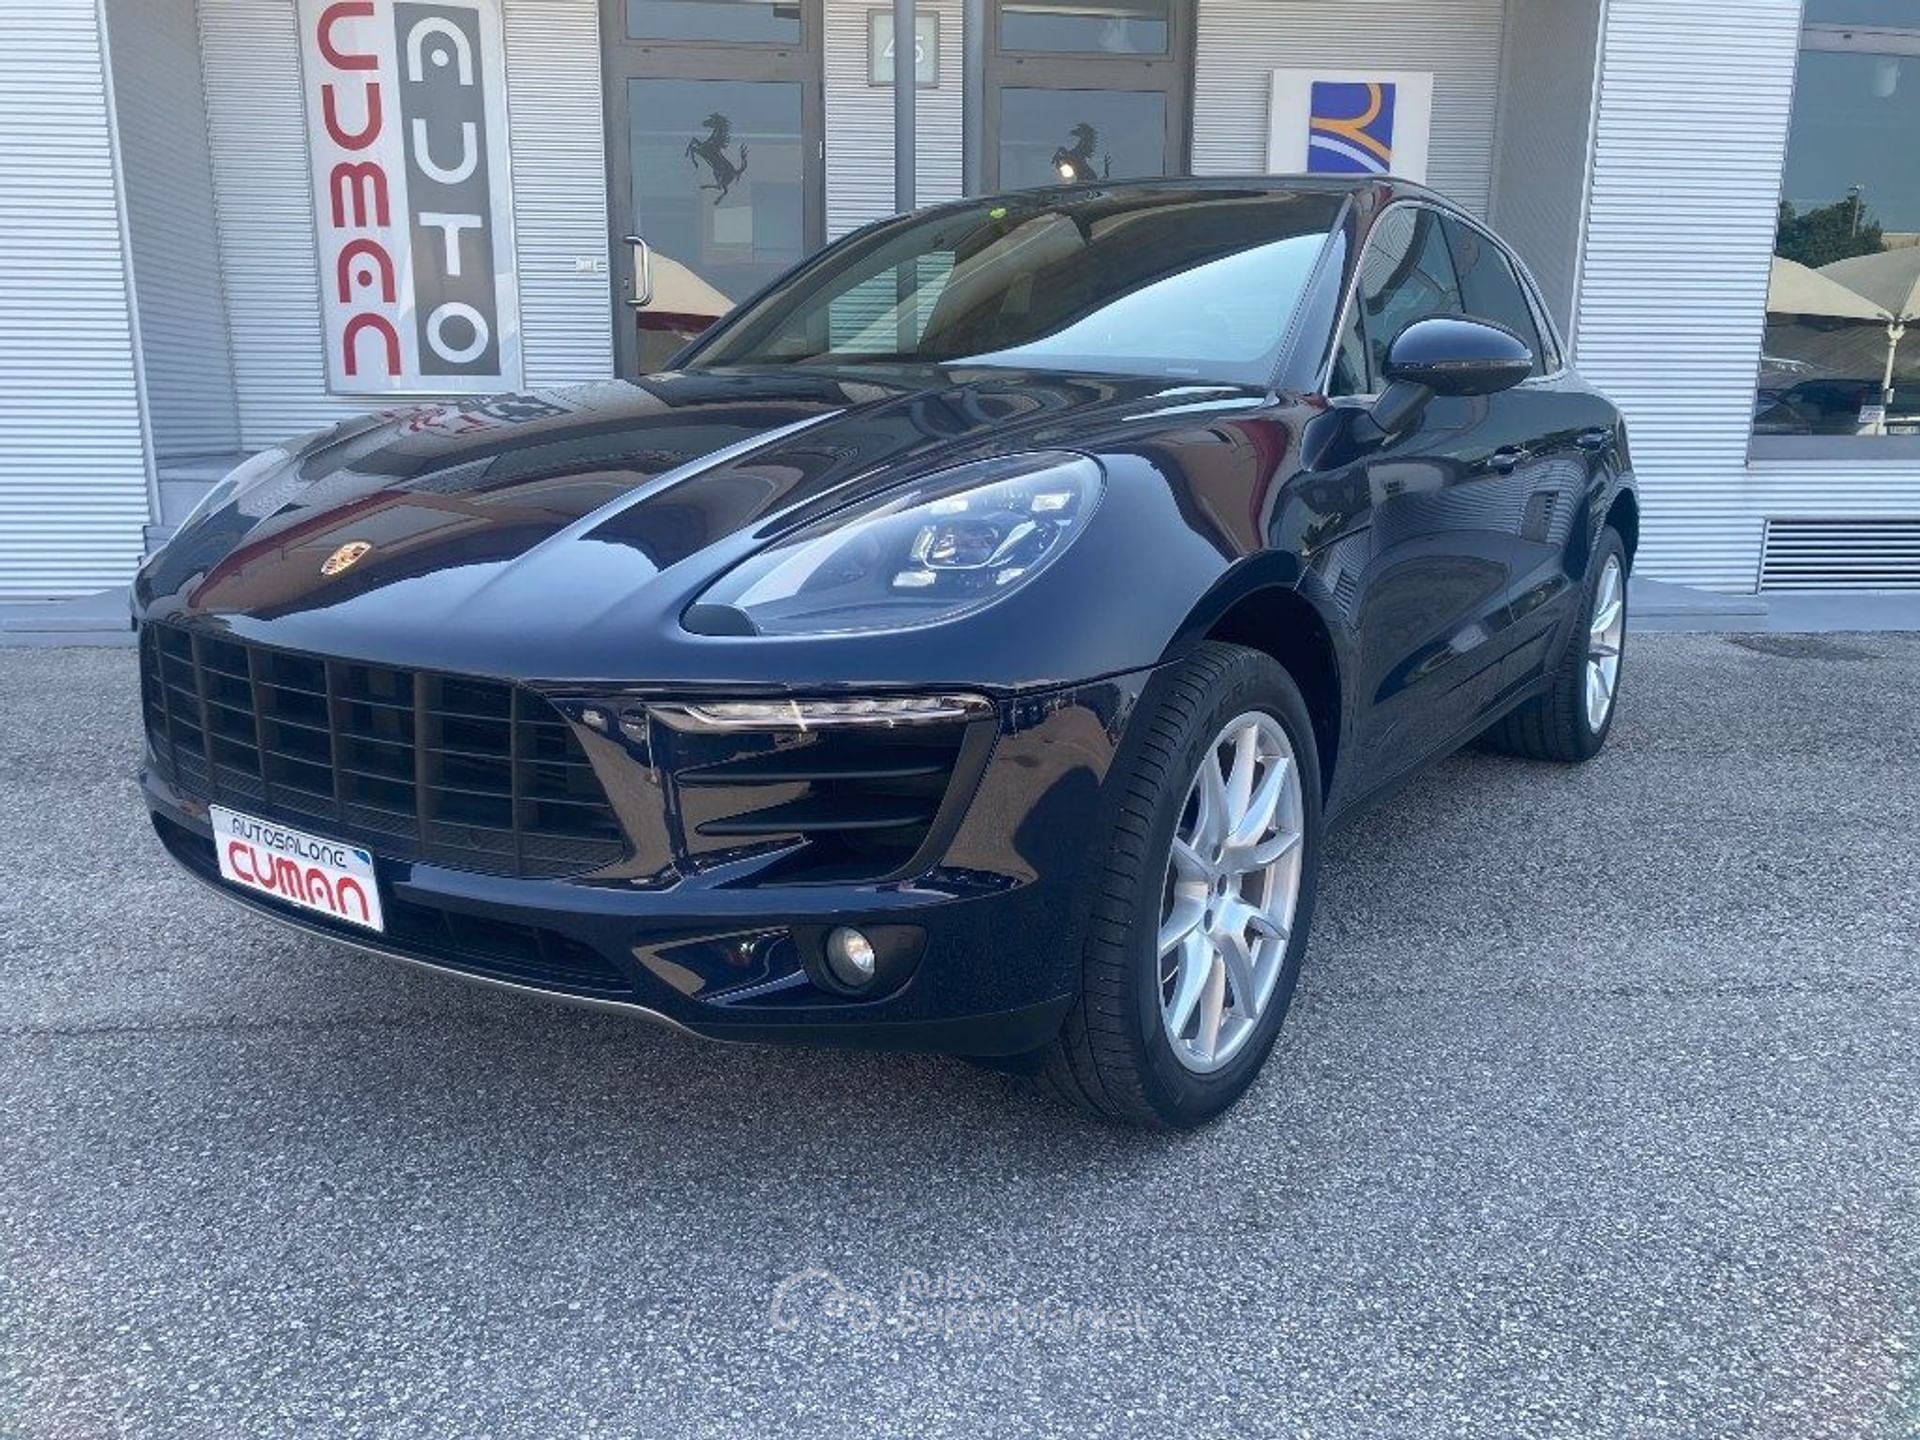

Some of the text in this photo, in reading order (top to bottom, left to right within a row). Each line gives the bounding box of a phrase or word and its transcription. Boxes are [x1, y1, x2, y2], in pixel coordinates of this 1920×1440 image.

[317, 1, 402, 376] CUMAN
[406, 16, 489, 364] AUTO
[228, 839, 369, 922] CUMAN
[231, 817, 347, 868] AUTOSALONE
